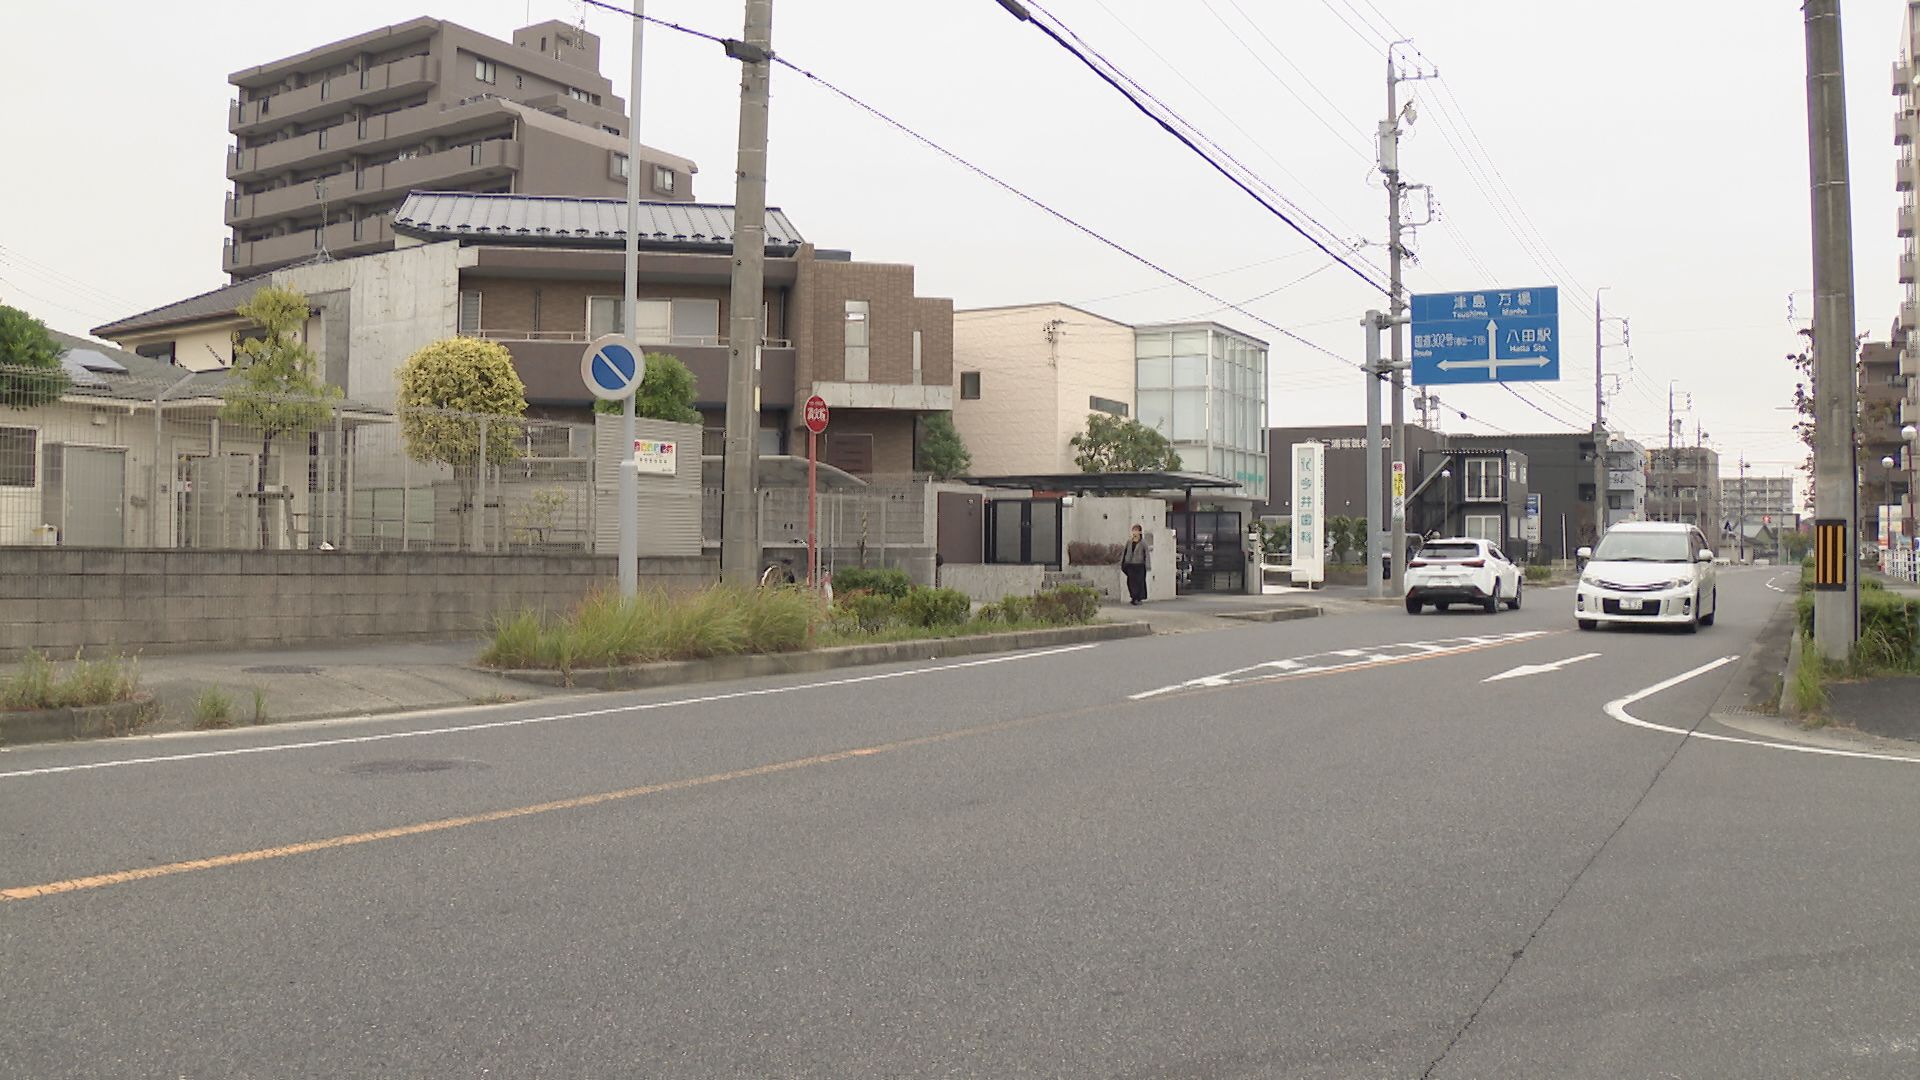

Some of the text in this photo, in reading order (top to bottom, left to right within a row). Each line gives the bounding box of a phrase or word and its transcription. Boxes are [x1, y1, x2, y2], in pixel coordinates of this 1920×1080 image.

[1454, 295, 1487, 309] 津島
[1506, 327, 1552, 343] 八田駅
